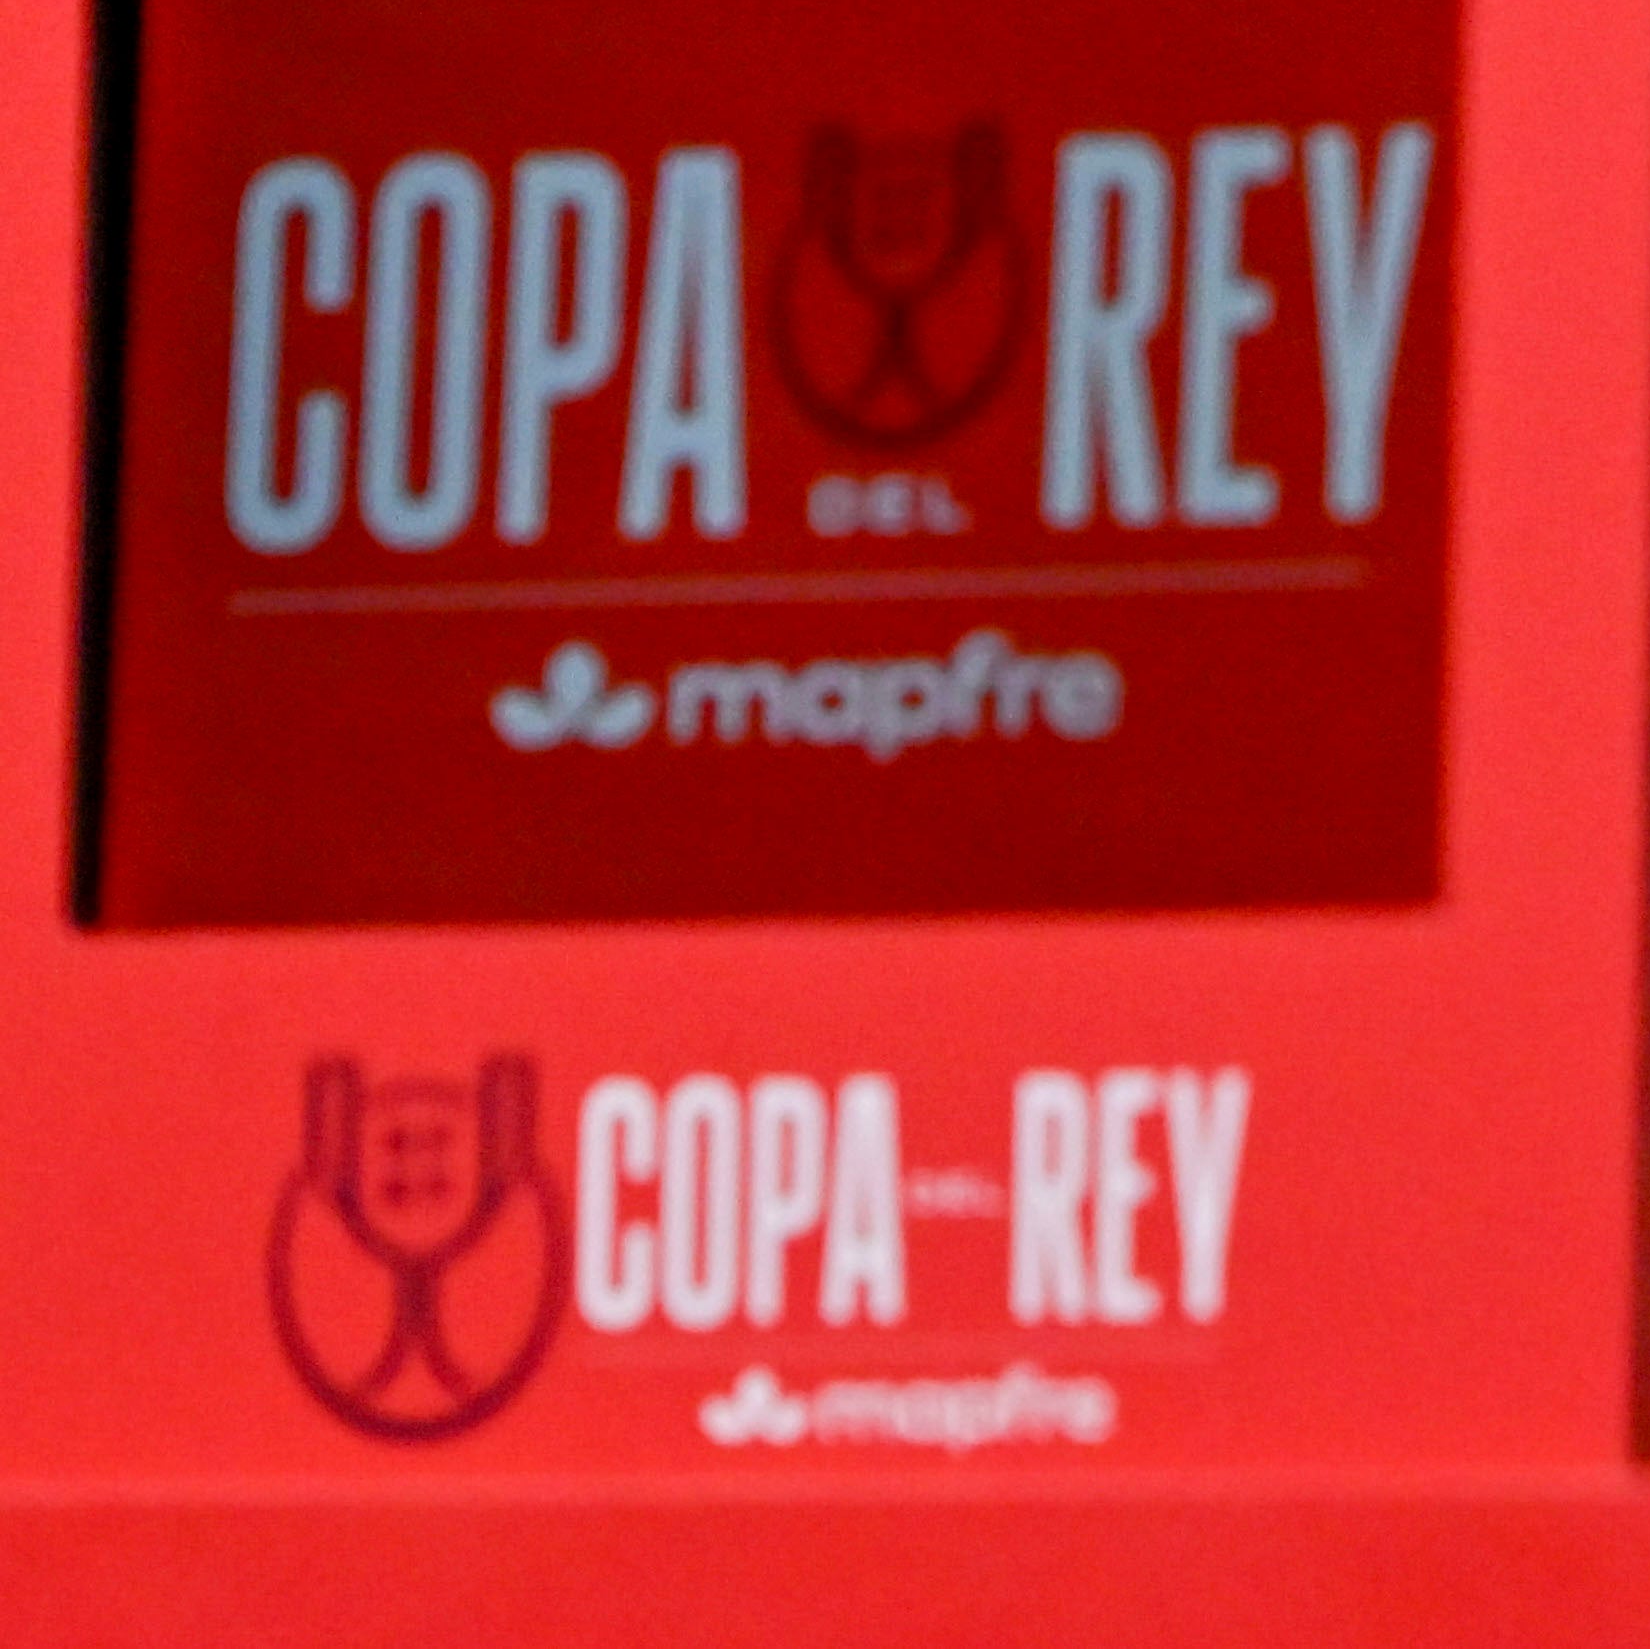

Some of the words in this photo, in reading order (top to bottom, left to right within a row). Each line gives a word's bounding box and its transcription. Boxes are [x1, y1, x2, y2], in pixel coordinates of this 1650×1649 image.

[225, 146, 747, 554] COPA
[1040, 120, 1435, 531] REY
[667, 628, 1124, 762] mapfre
[575, 1072, 906, 1331] COPA
[1008, 1064, 1251, 1327] REY
